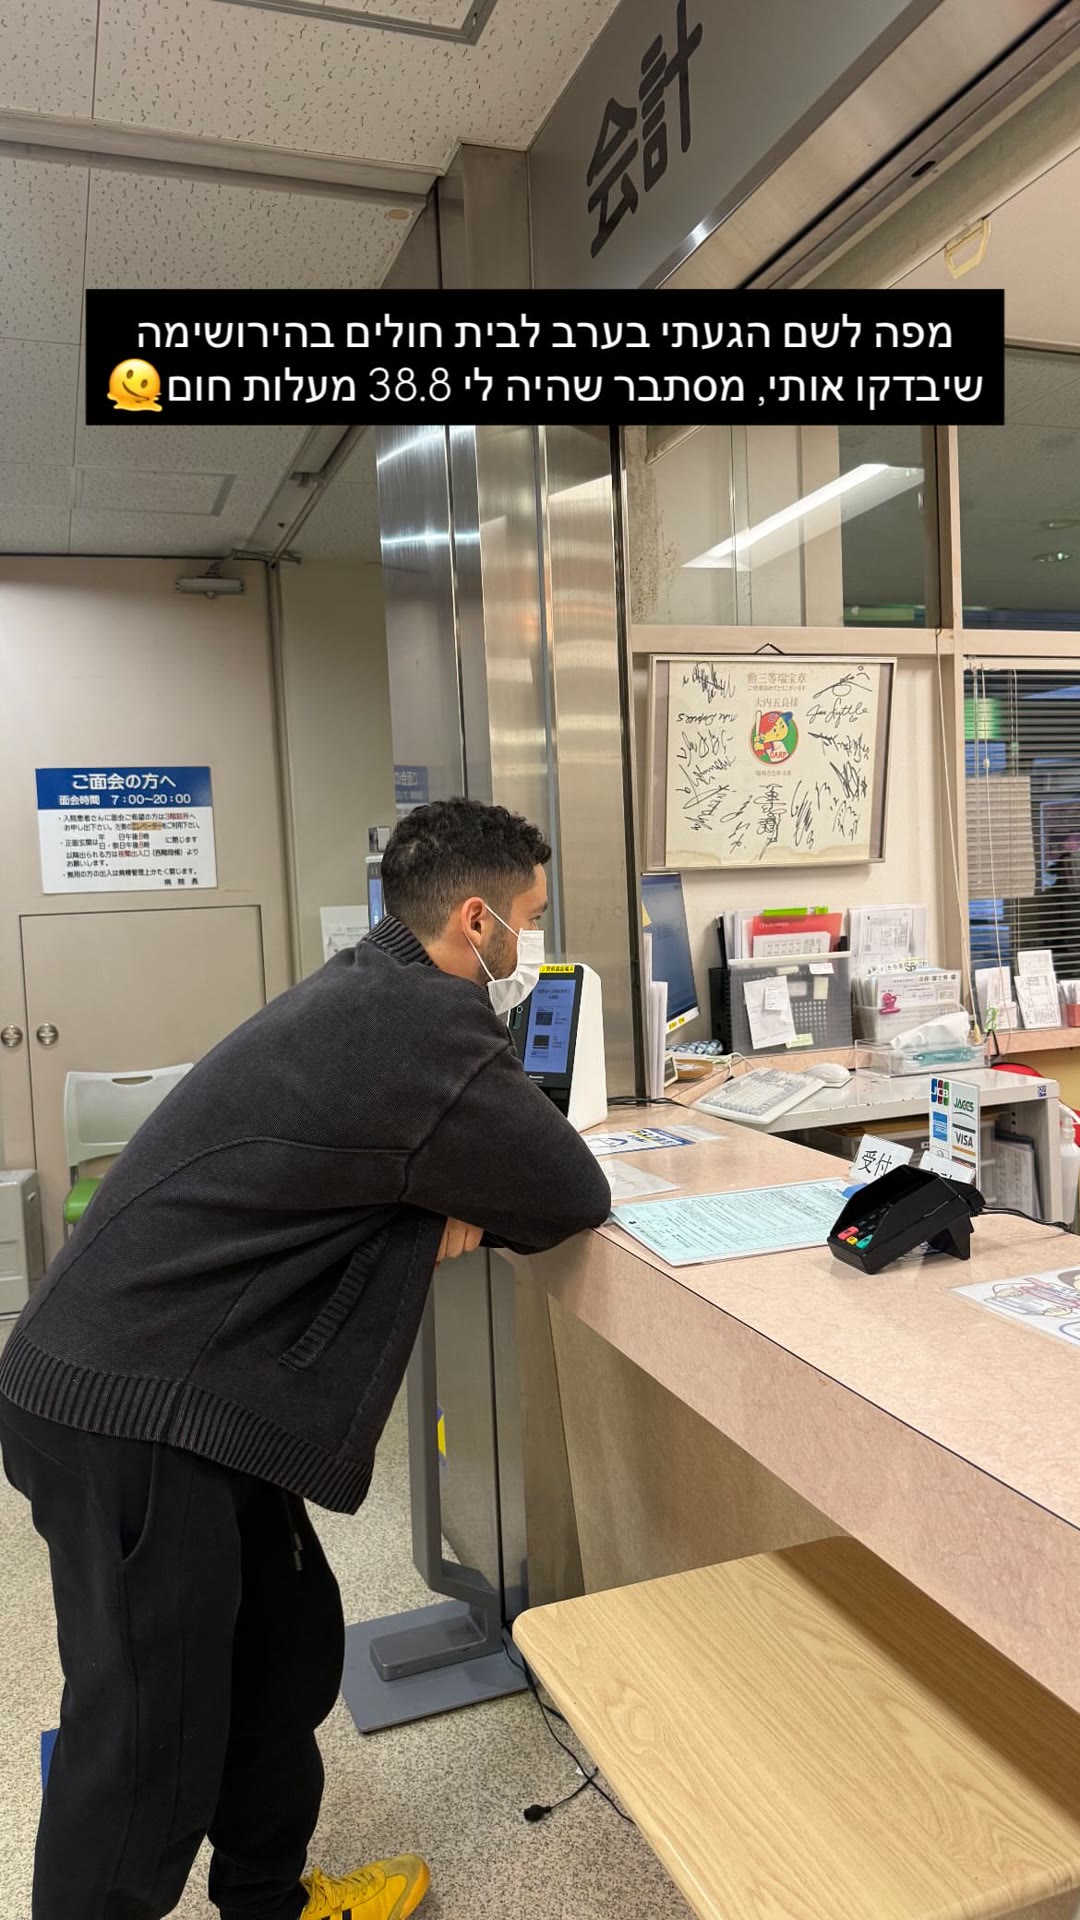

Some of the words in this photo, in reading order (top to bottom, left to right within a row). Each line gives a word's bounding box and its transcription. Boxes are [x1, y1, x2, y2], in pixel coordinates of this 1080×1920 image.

[586, 0, 704, 259] 会計
[770, 751, 787, 759] CARP
[73, 773, 176, 790] ご面会の方へ
[59, 795, 100, 805] 面会時間
[955, 1131, 974, 1148] VISA
[858, 1150, 893, 1177] 受付
